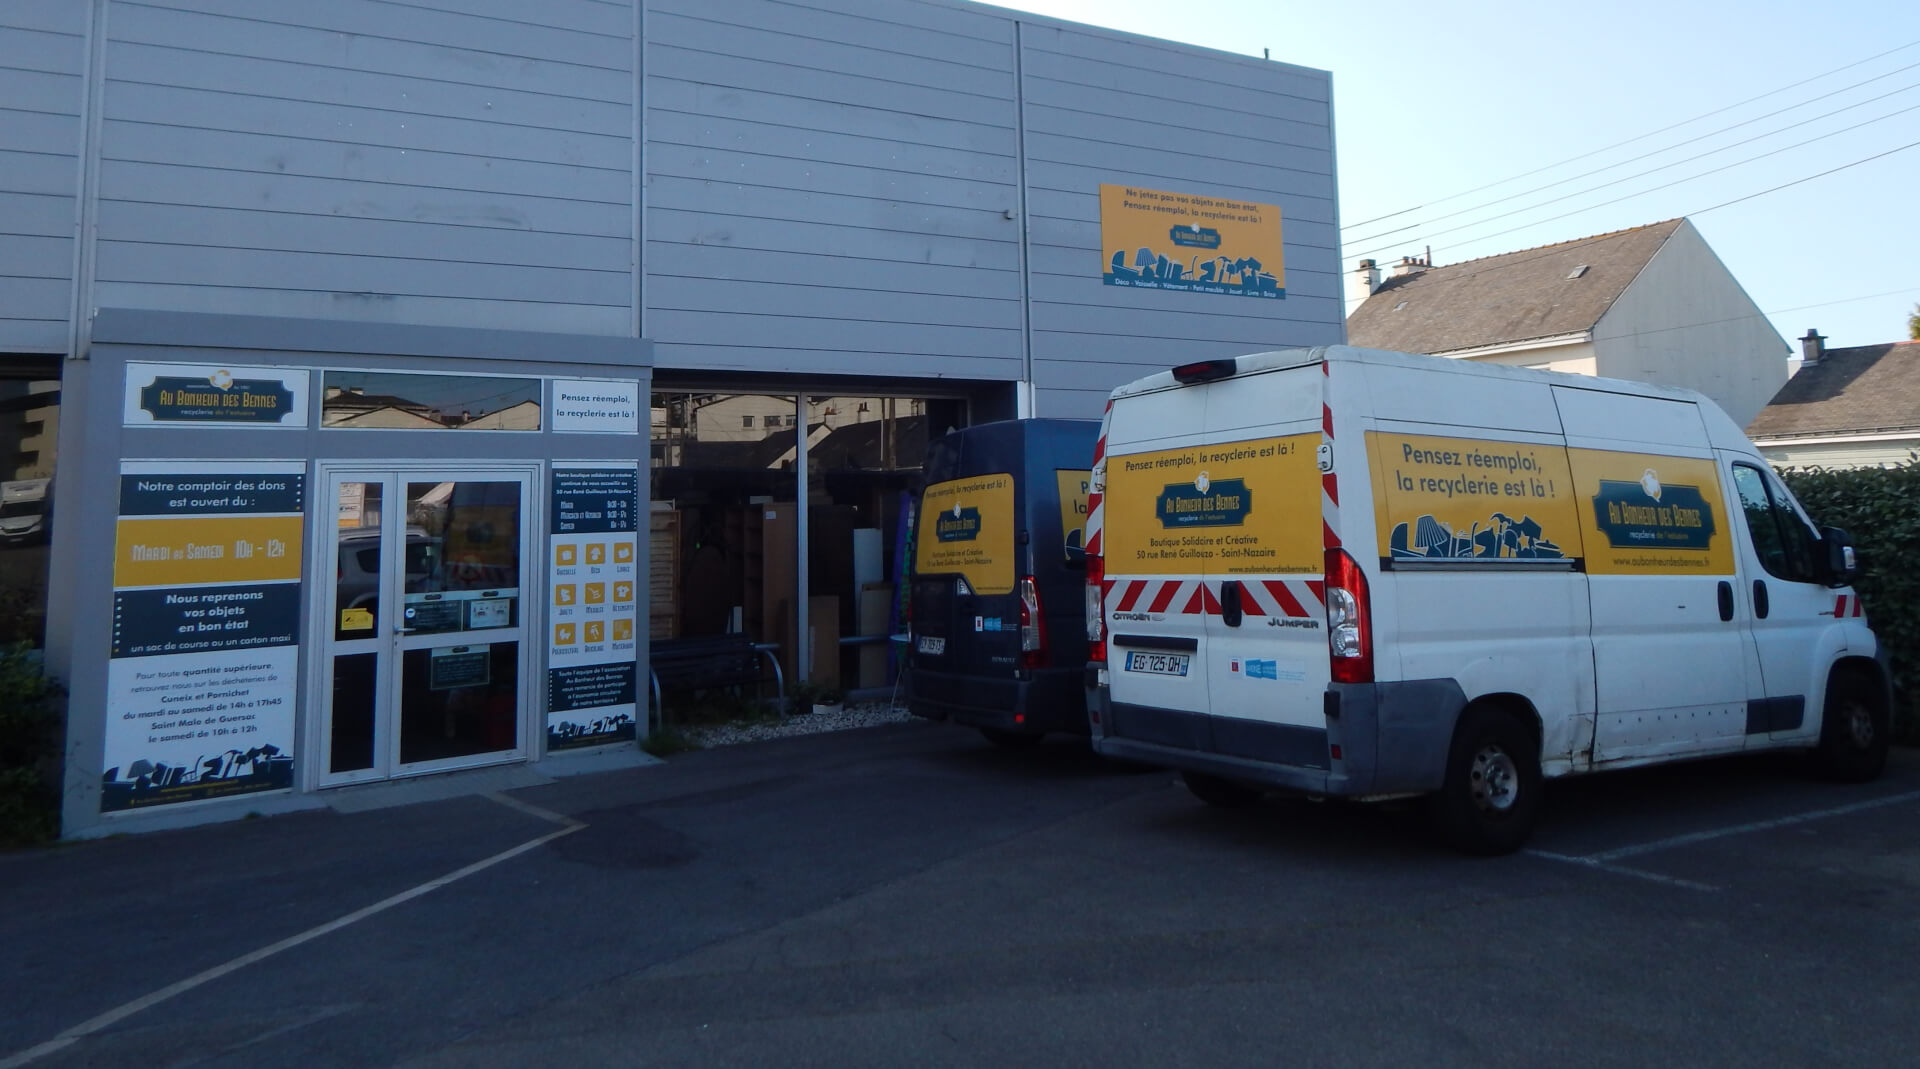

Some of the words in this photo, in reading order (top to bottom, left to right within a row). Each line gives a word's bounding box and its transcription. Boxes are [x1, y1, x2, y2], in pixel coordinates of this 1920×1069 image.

[1160, 195, 1174, 203] pas
[1191, 196, 1214, 206] objets
[1227, 200, 1240, 209] bon
[1123, 200, 1151, 211] Pensez
[1192, 208, 1199, 216] la
[1201, 210, 1236, 221] recyclerie
[1238, 214, 1249, 222] est
[561, 393, 590, 402] Pensez
[592, 394, 630, 404] réemploi,
[181, 409, 213, 417] recyclerie
[556, 409, 565, 417] la
[567, 410, 606, 419] recyclerie
[608, 410, 620, 418] est
[1125, 460, 1153, 472] Pensez
[1155, 453, 1197, 468] réemploi,
[1199, 452, 1207, 463] la
[1211, 448, 1256, 464] recyclerie
[1260, 445, 1274, 457] est
[1278, 443, 1287, 455] là
[1402, 443, 1462, 467] Pensez
[1466, 448, 1541, 475] réemploi,
[138, 481, 174, 491] Notre
[178, 481, 232, 493] comptoir
[235, 480, 254, 490] des
[258, 480, 286, 490] dons
[1396, 469, 1414, 491] la
[1420, 473, 1499, 499] recyclerie
[1504, 479, 1526, 497] est
[1530, 477, 1546, 498] là
[1549, 479, 1556, 498] !
[170, 498, 187, 507] est
[191, 498, 229, 507] ouvert
[232, 496, 248, 506] du
[1150, 538, 1180, 548] Boutique
[1182, 536, 1213, 546] Solidaire
[1216, 537, 1223, 545] et
[1225, 535, 1258, 545] Créative
[1160, 550, 1177, 558] René
[1221, 548, 1275, 558] Saint-Nazaire
[167, 594, 198, 604] Nous
[202, 591, 264, 604] reprenons
[184, 609, 206, 618] vos
[209, 606, 246, 617] objets
[178, 625, 195, 633] en
[199, 622, 222, 632] bon
[225, 619, 249, 630] état
[1268, 617, 1319, 629] JUMPER
[165, 642, 176, 650] de
[180, 641, 209, 649] course
[240, 636, 268, 644] carton
[270, 633, 291, 642] maxi
[136, 671, 156, 680] Pour
[159, 669, 181, 677] toute
[183, 667, 221, 677] quantité
[131, 684, 170, 693] retrouvez
[161, 694, 192, 704] Cuneix
[195, 693, 205, 701] et
[207, 689, 249, 699] Pornichet
[122, 711, 136, 720] du
[139, 709, 165, 717] mardi
[168, 707, 179, 715] au
[181, 704, 214, 714] samedi
[217, 702, 227, 710] de
[230, 701, 245, 710] 14h
[256, 697, 282, 707] 17h45
[151, 721, 176, 730] Saint
[179, 719, 202, 727] Malo
[205, 716, 216, 724] de
[219, 713, 256, 724] Guersac
[148, 735, 157, 743] le
[160, 731, 195, 742] samedi
[198, 730, 209, 738] de
[213, 728, 229, 736] 10h
[241, 725, 257, 733] 12h
